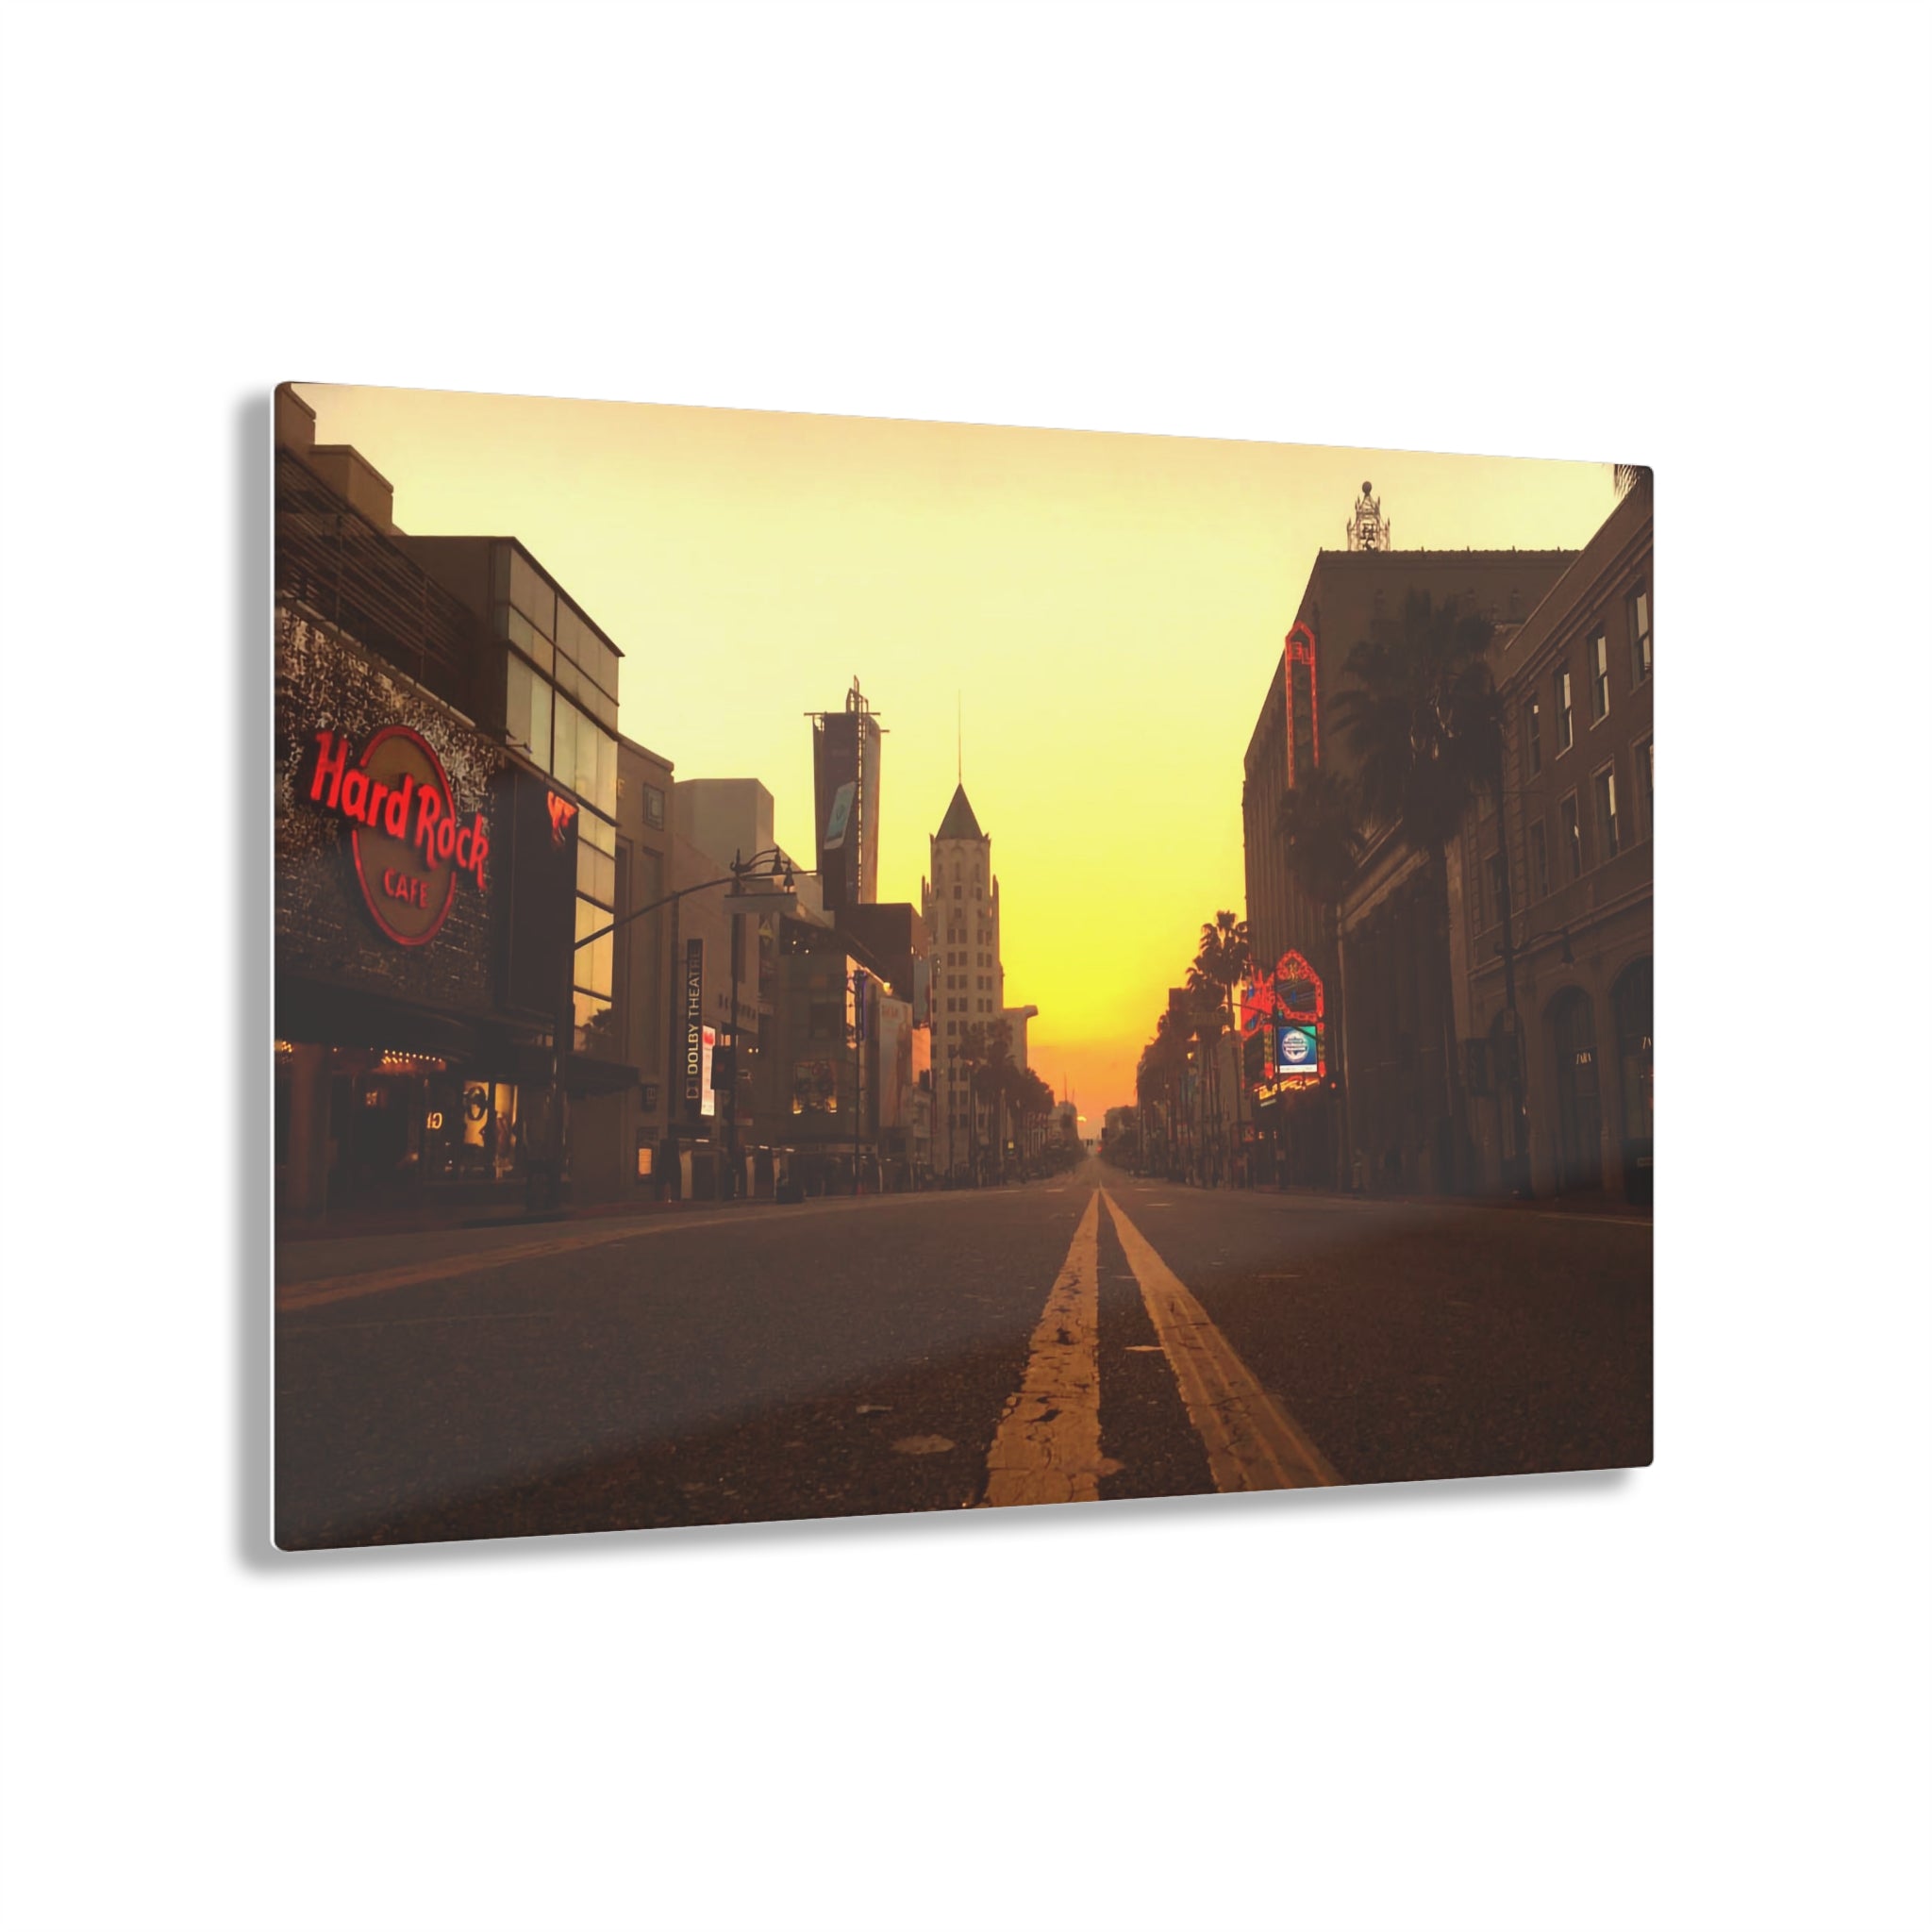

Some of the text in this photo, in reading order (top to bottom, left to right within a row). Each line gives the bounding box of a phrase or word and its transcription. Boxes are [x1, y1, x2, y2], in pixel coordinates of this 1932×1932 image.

[310, 730, 490, 891] Hard Rock
[384, 868, 429, 908] CAFE
[687, 1023, 699, 1074] DOLBY
